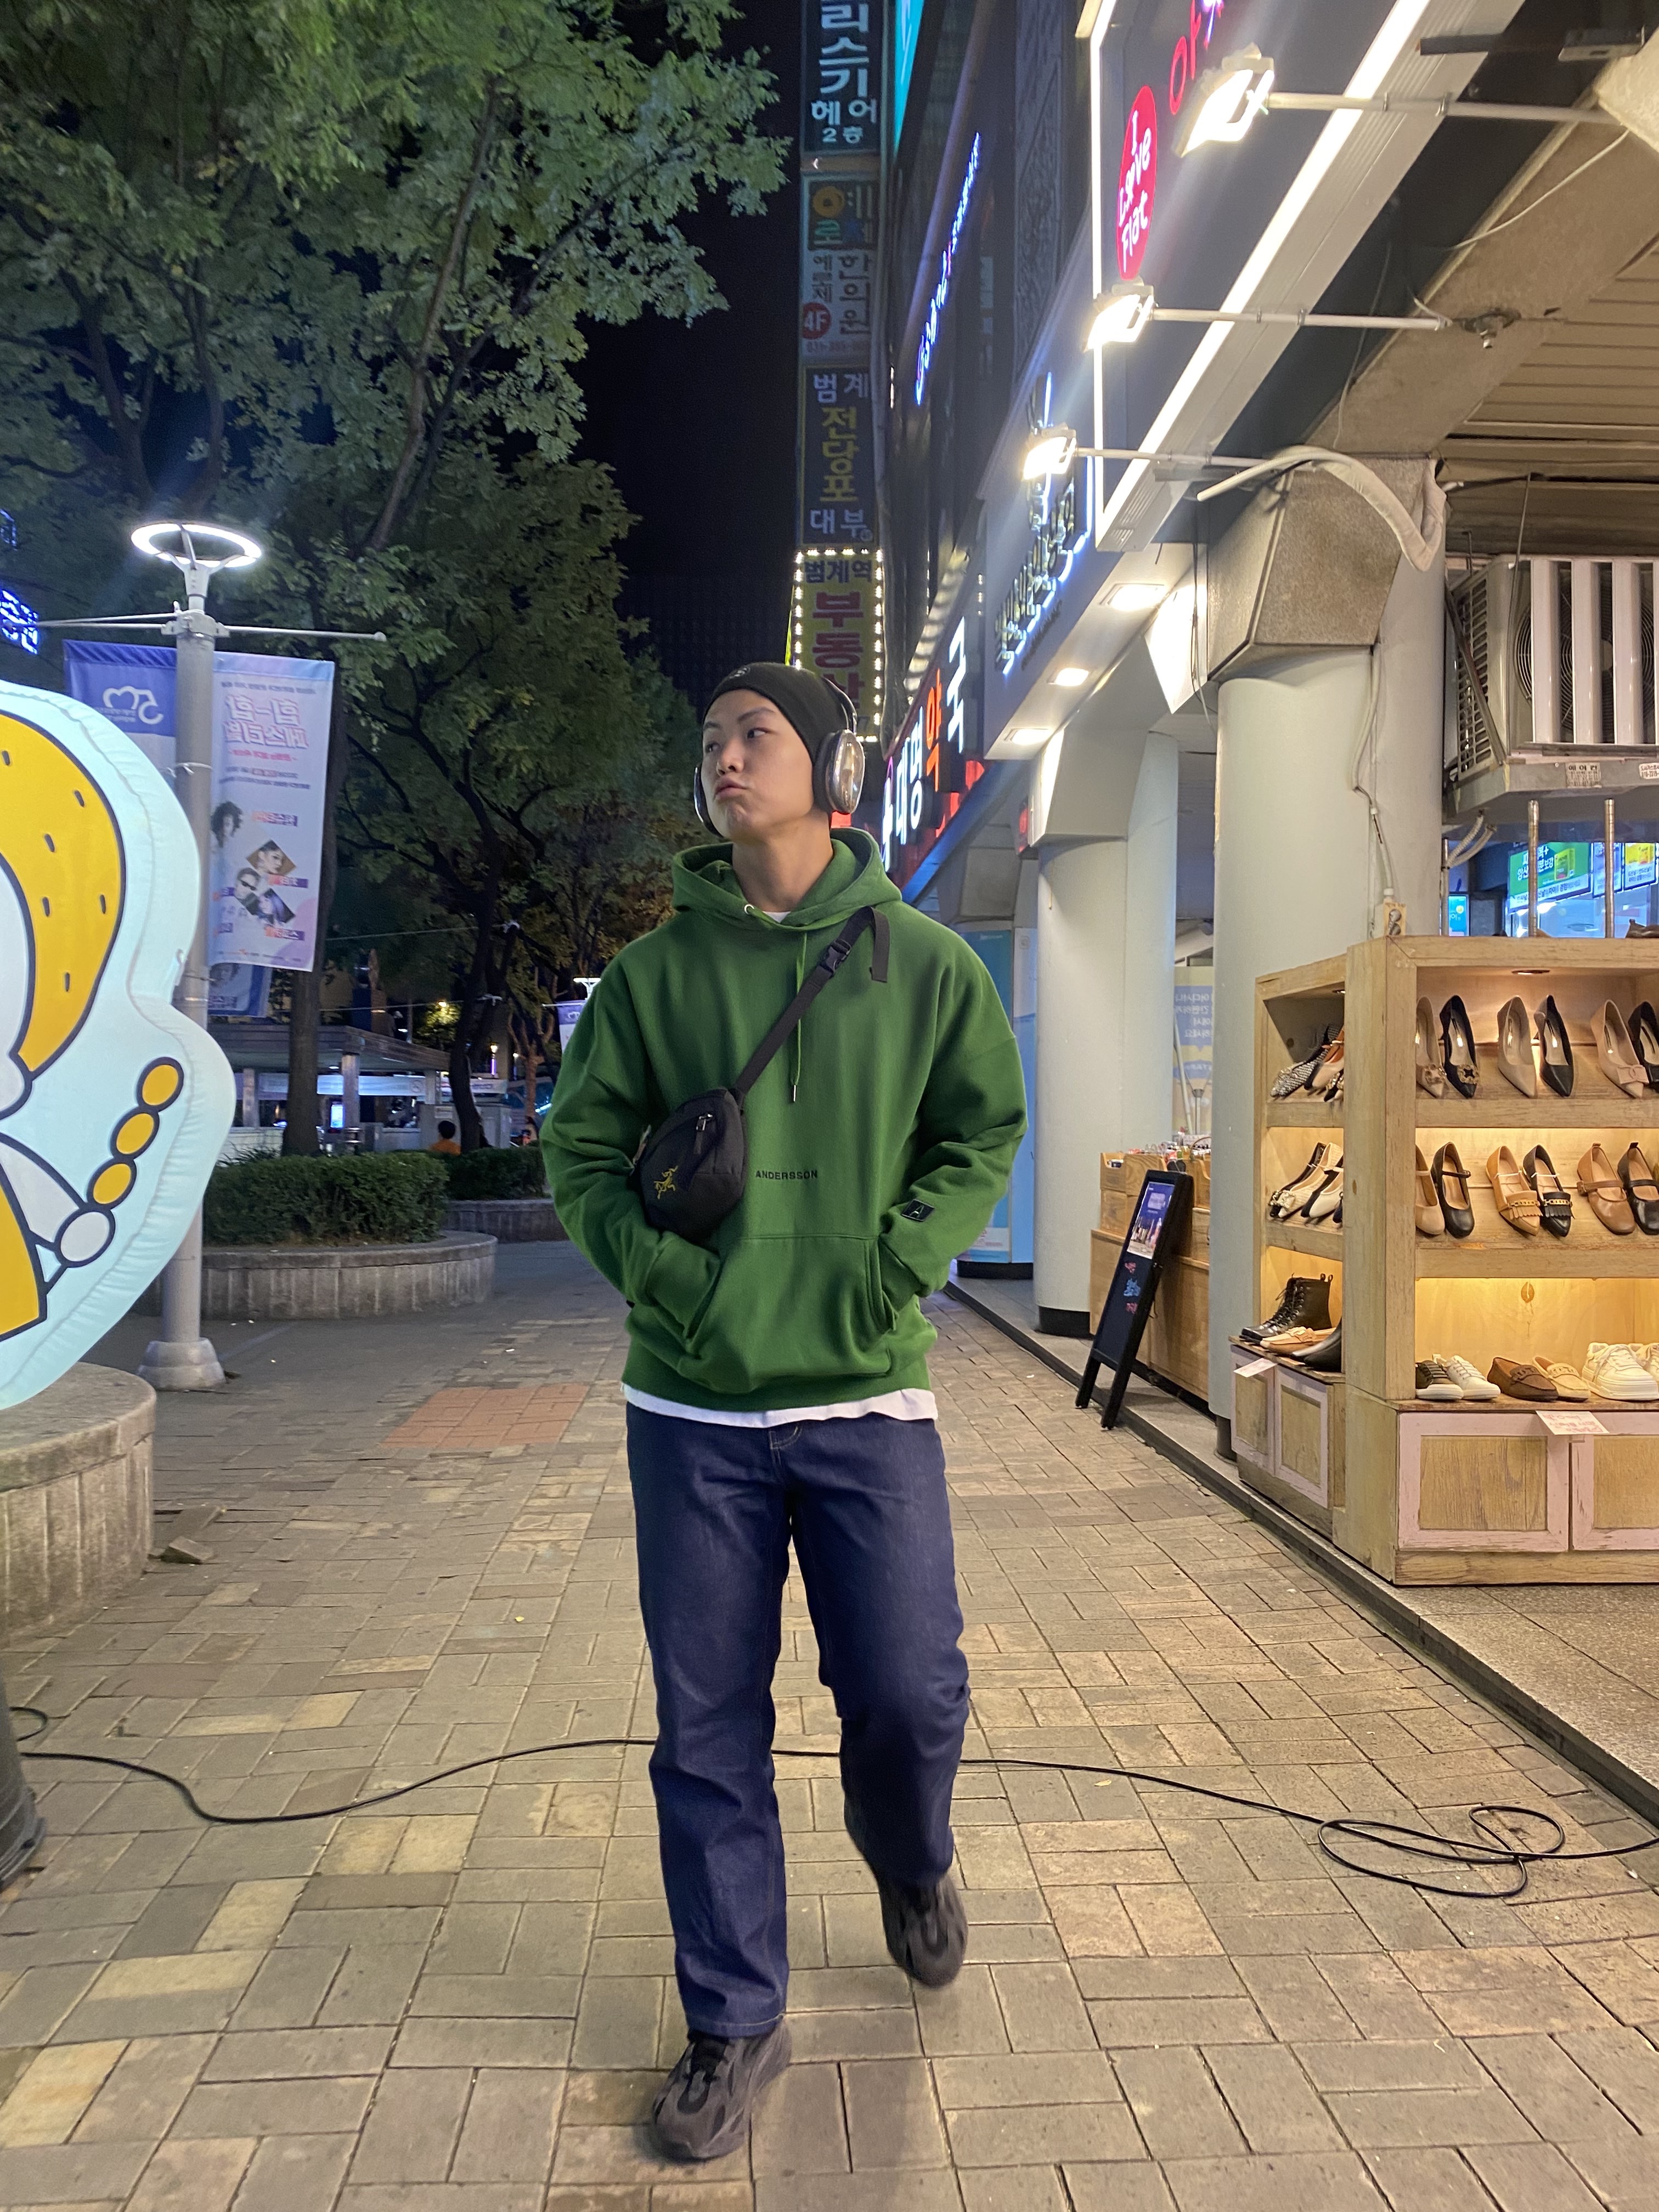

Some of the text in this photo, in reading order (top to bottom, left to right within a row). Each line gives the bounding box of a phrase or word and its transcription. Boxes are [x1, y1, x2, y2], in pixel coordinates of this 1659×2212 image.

[819, 0, 870, 97] 리스기
[804, 311, 828, 331] 4F
[813, 373, 870, 404] 범계
[819, 406, 859, 503] 전당포
[810, 509, 870, 538] 대부
[804, 559, 872, 584] 범계역
[895, 616, 966, 845] 대명약국
[755, 1170, 819, 1180] ANDERSSON
